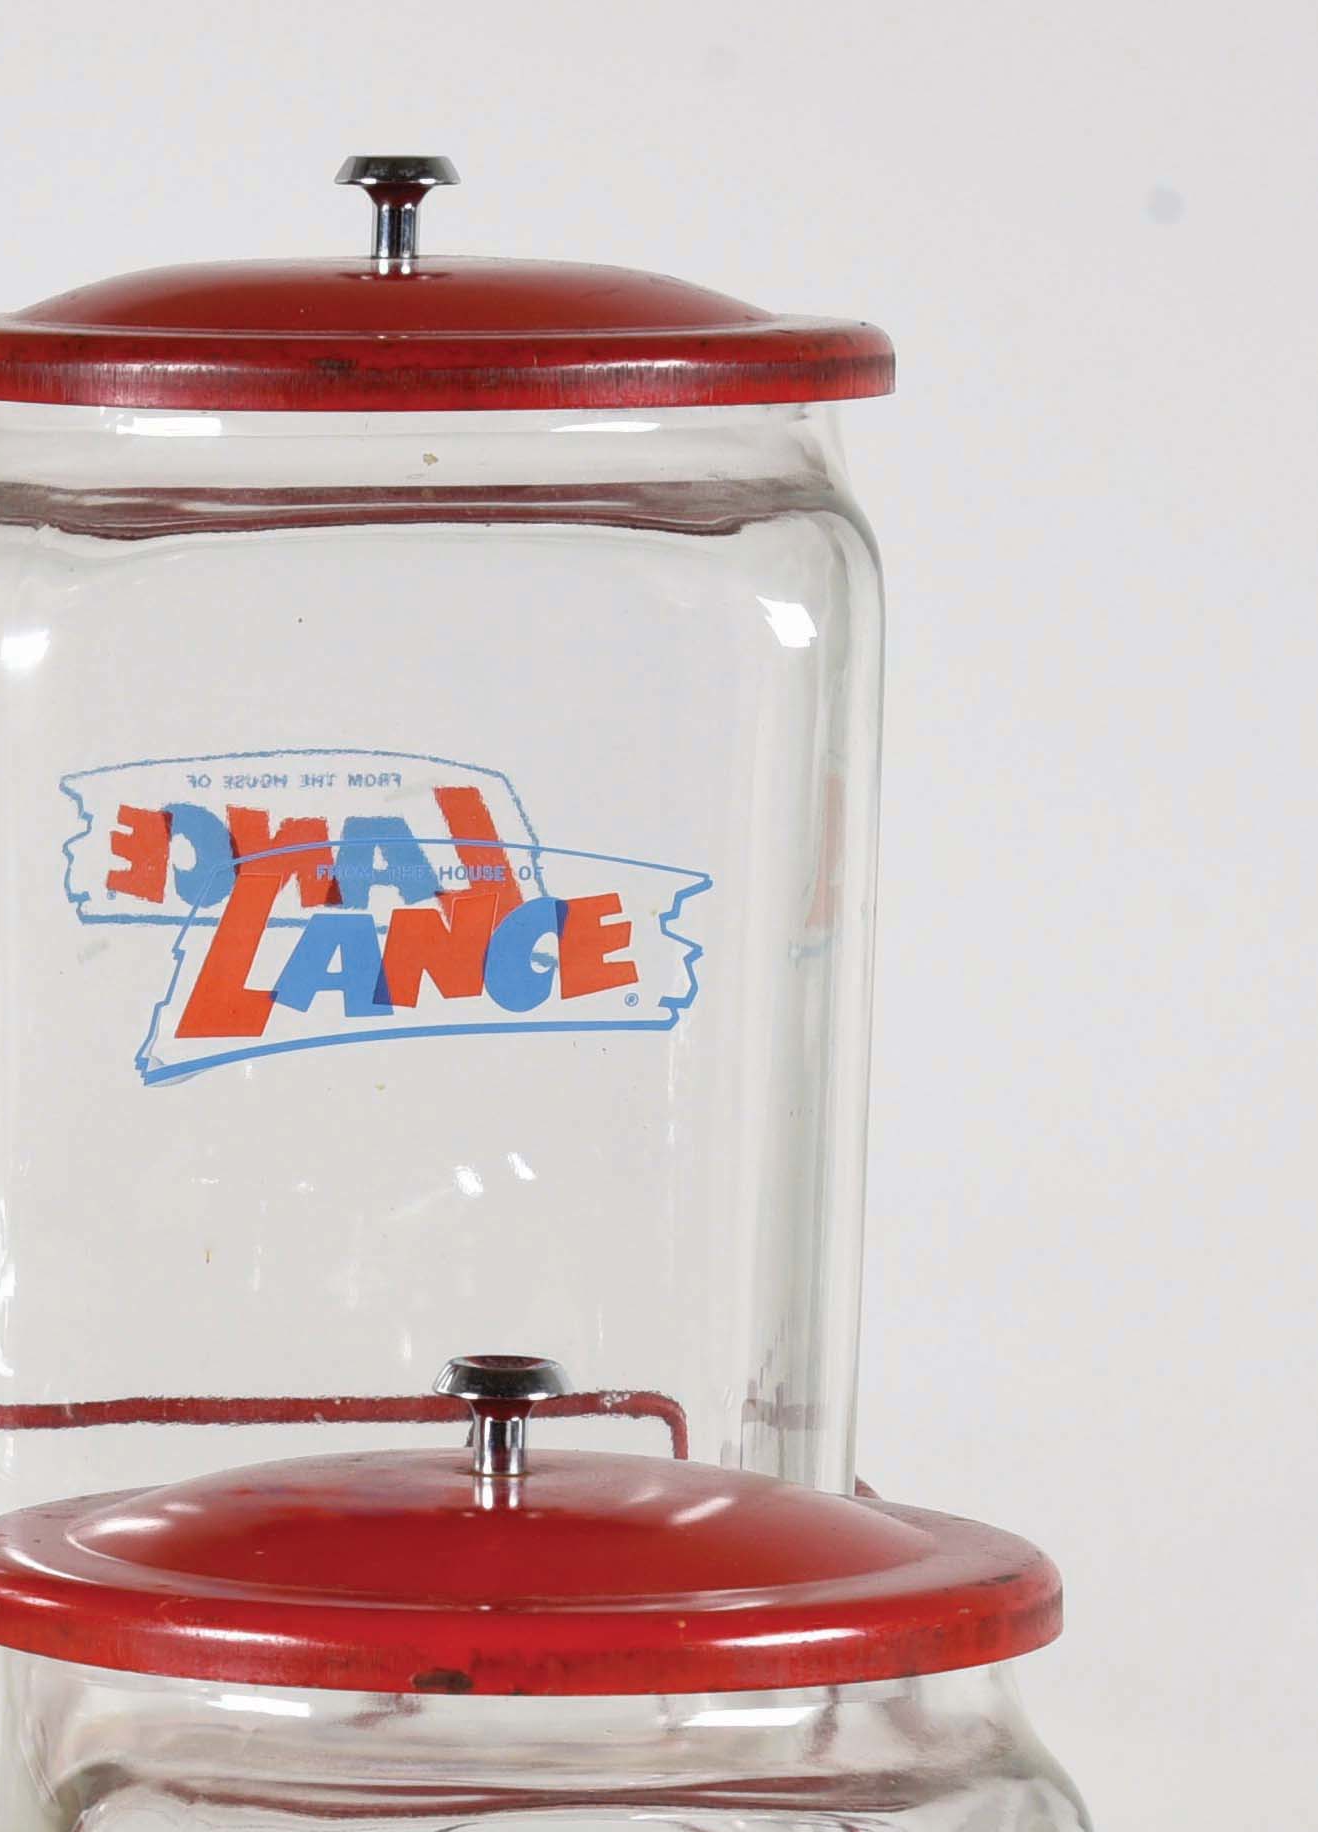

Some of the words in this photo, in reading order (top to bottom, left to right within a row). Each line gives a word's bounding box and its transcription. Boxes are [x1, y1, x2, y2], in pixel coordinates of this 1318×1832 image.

[439, 865, 506, 881] HOUSE
[519, 865, 545, 881] OF
[174, 872, 639, 1039] LANCE
